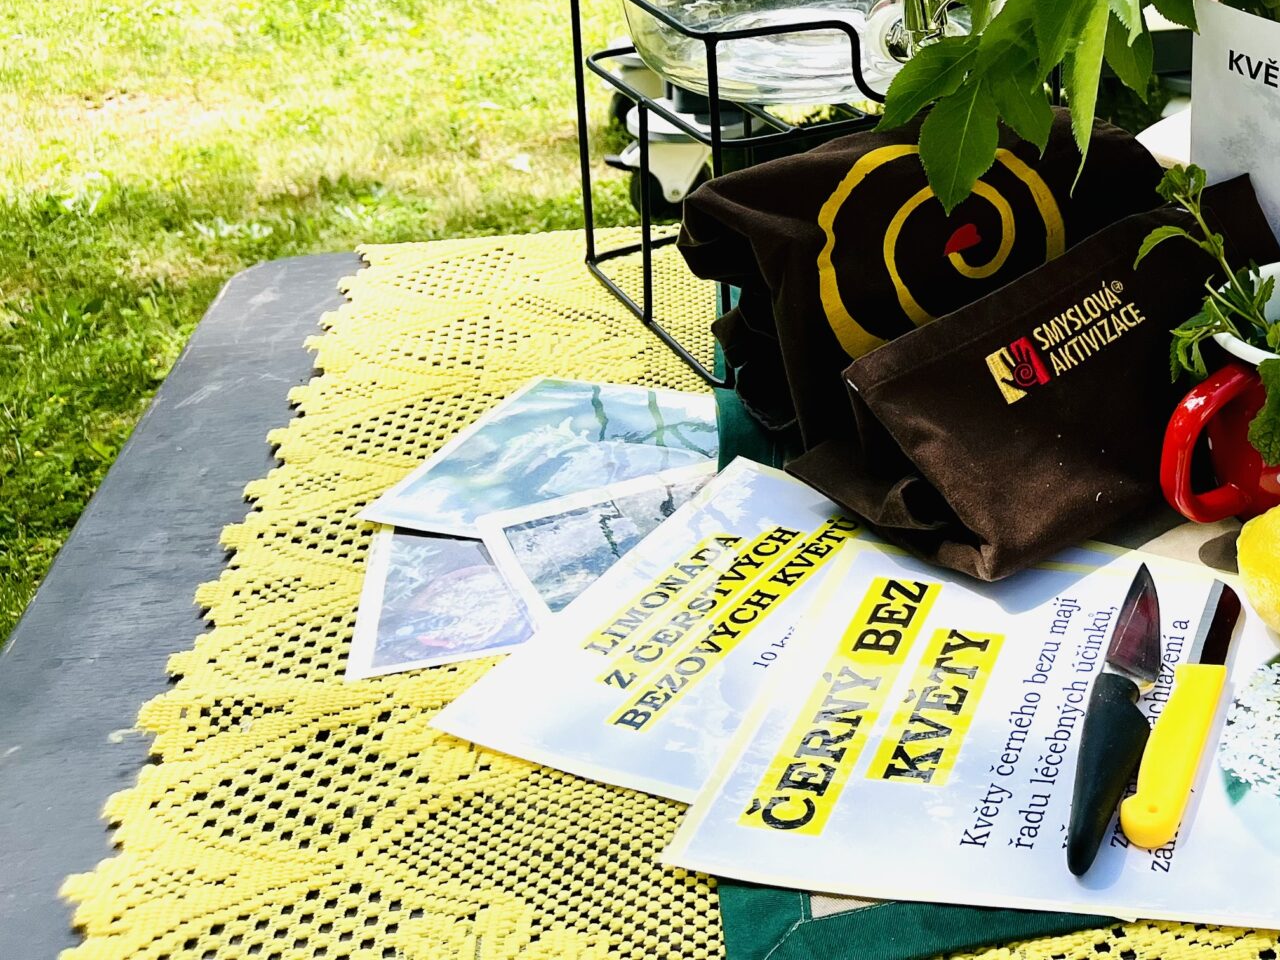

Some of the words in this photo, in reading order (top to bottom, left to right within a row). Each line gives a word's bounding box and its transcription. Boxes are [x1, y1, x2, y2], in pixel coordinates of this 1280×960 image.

[1048, 302, 1146, 376] AKTIVIZACE
[584, 534, 742, 656] LIMONÁDA
[604, 669, 638, 690] Z
[625, 526, 801, 664] ČERSTVÝCH
[613, 589, 779, 731] BEZOVÝCH
[769, 516, 860, 587] KVĚTŮ
[752, 651, 778, 669] 10
[1144, 634, 1184, 730] achlazení
[1172, 619, 1190, 630] a
[745, 666, 882, 830] ČERNÝ
[852, 579, 929, 656] BEZ
[882, 629, 990, 784] KVĚTY
[960, 782, 1013, 848] Květy
[989, 691, 1041, 777] černého
[1023, 640, 1062, 685] bezu
[1050, 596, 1082, 636] mají
[1007, 789, 1051, 850] řadu
[1029, 680, 1089, 786] léčebných
[1075, 603, 1119, 674] účinků,
